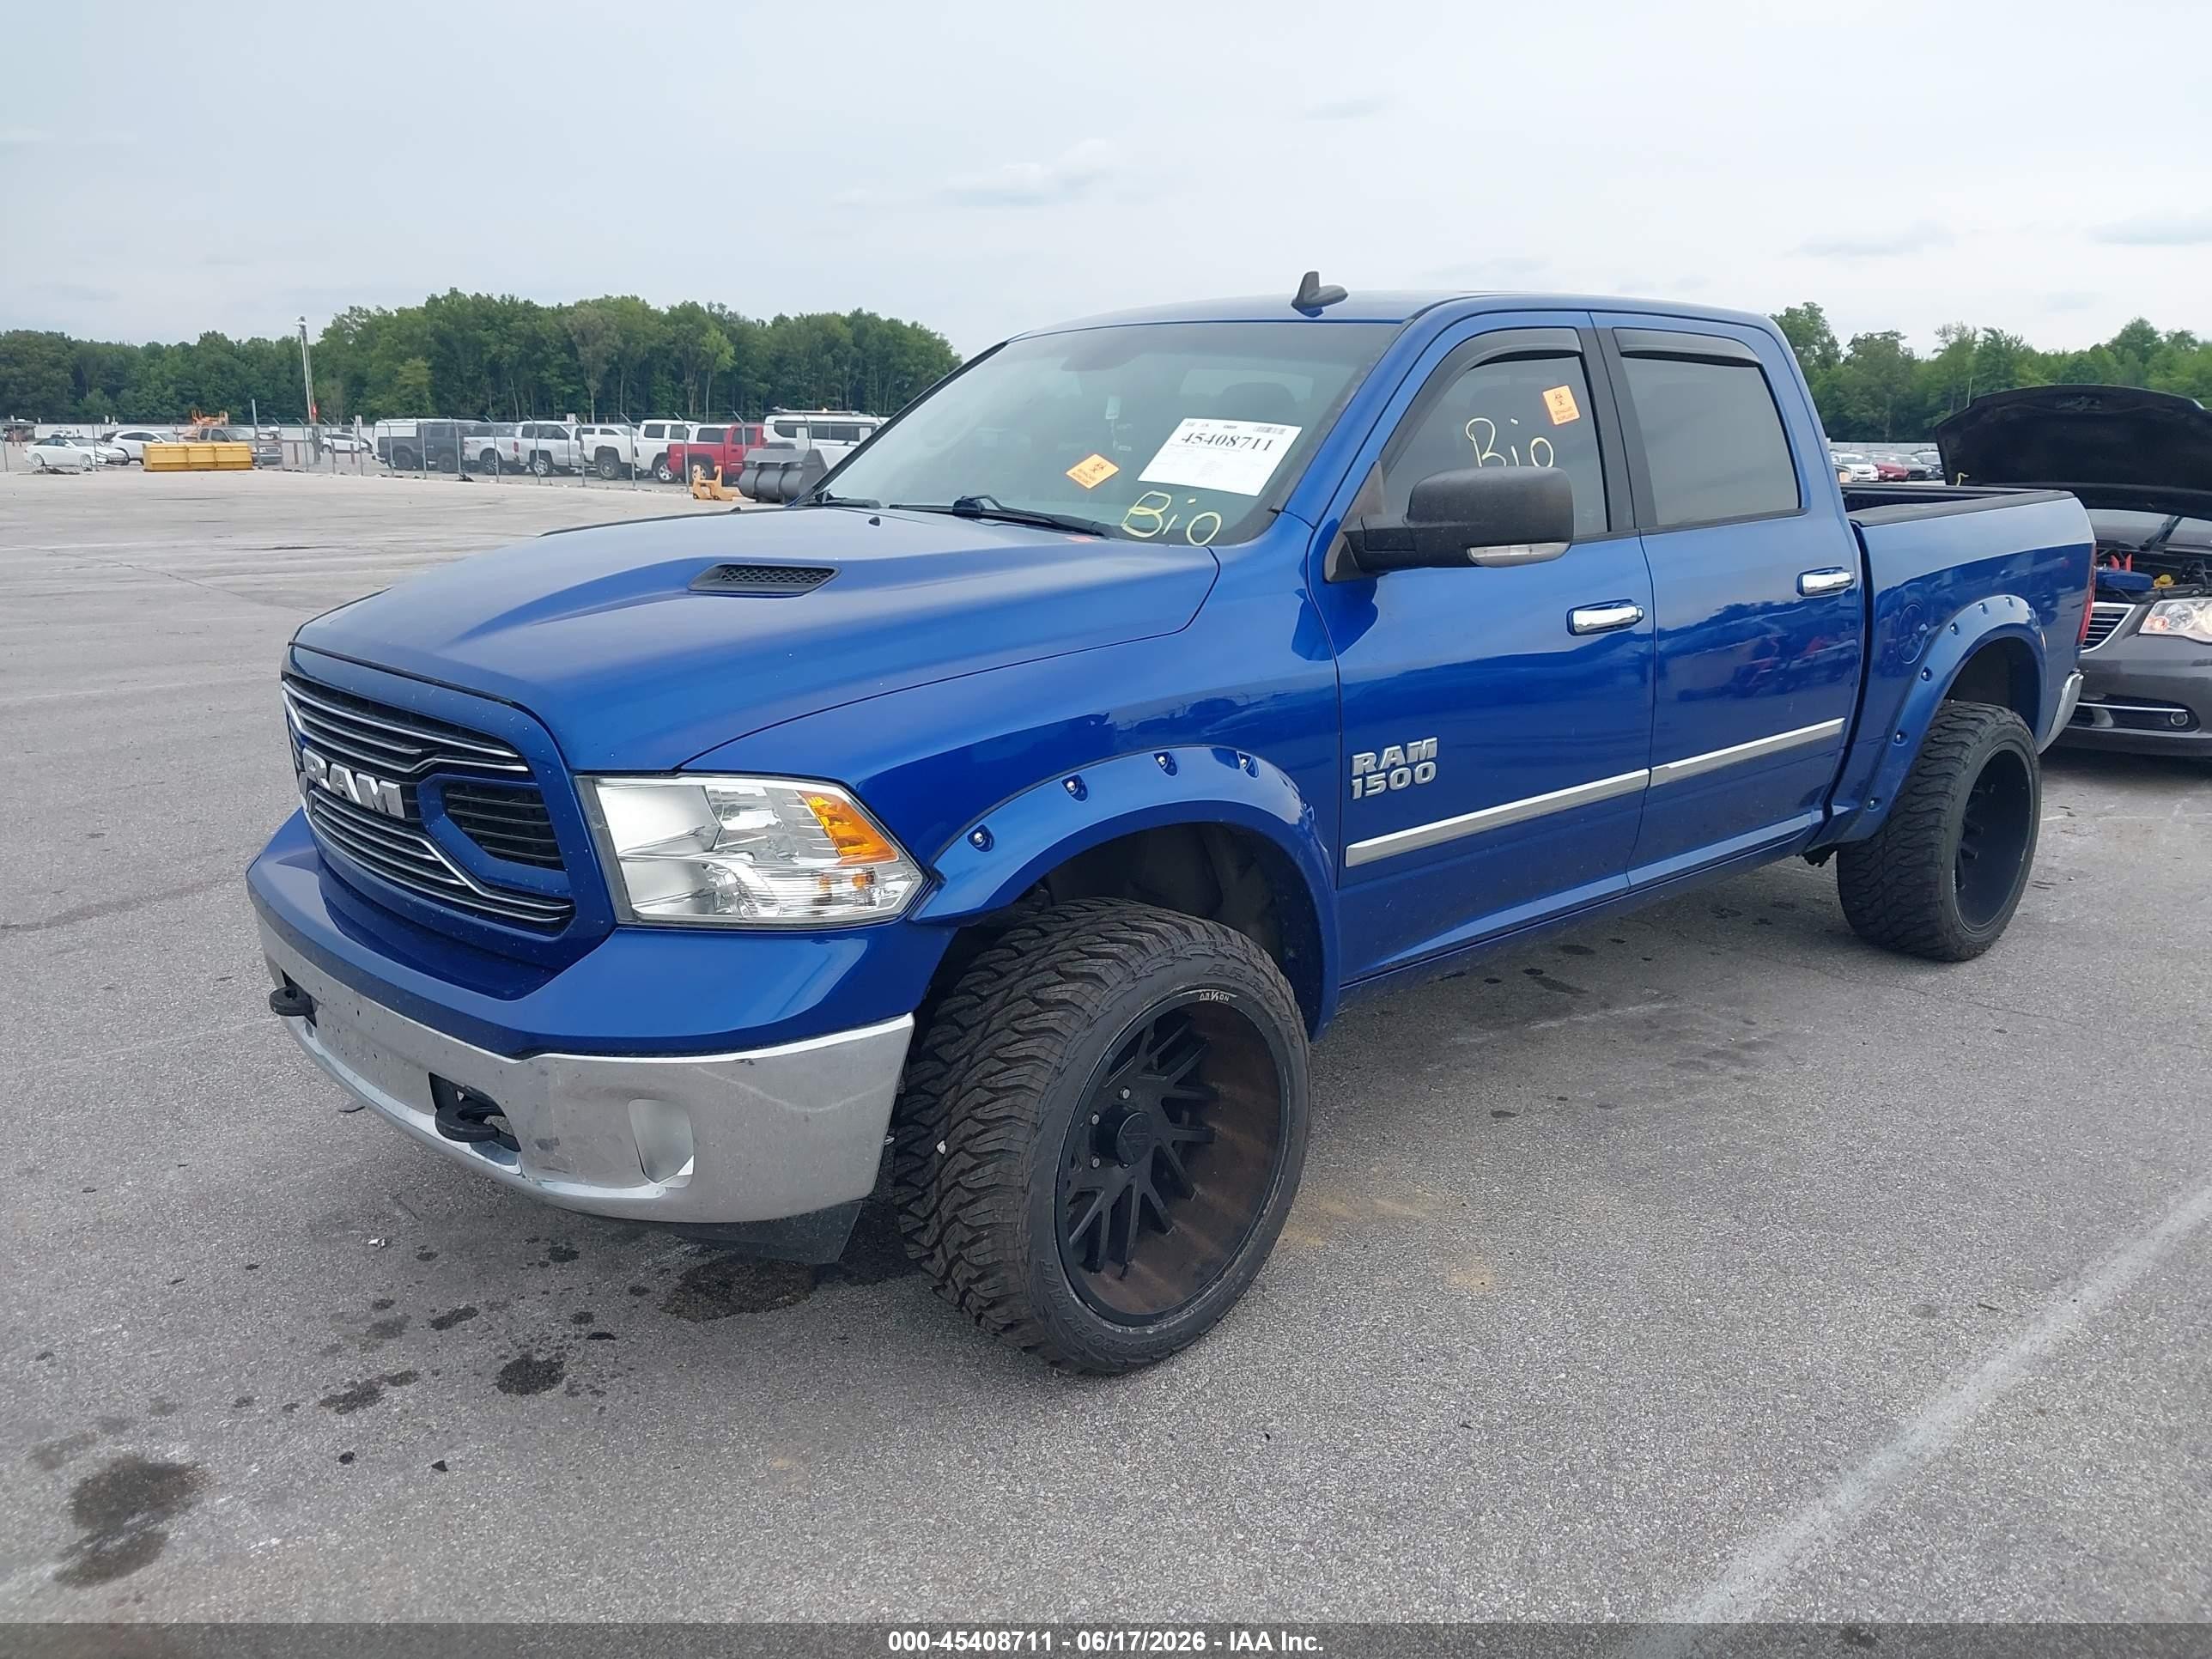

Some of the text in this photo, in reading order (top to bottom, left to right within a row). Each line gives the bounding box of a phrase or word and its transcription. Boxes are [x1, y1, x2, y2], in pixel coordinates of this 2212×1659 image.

[1181, 432, 1274, 451] 45408711
[1352, 737, 1437, 776] RAM
[301, 747, 405, 818] RAM
[1351, 761, 1437, 799] 1500
